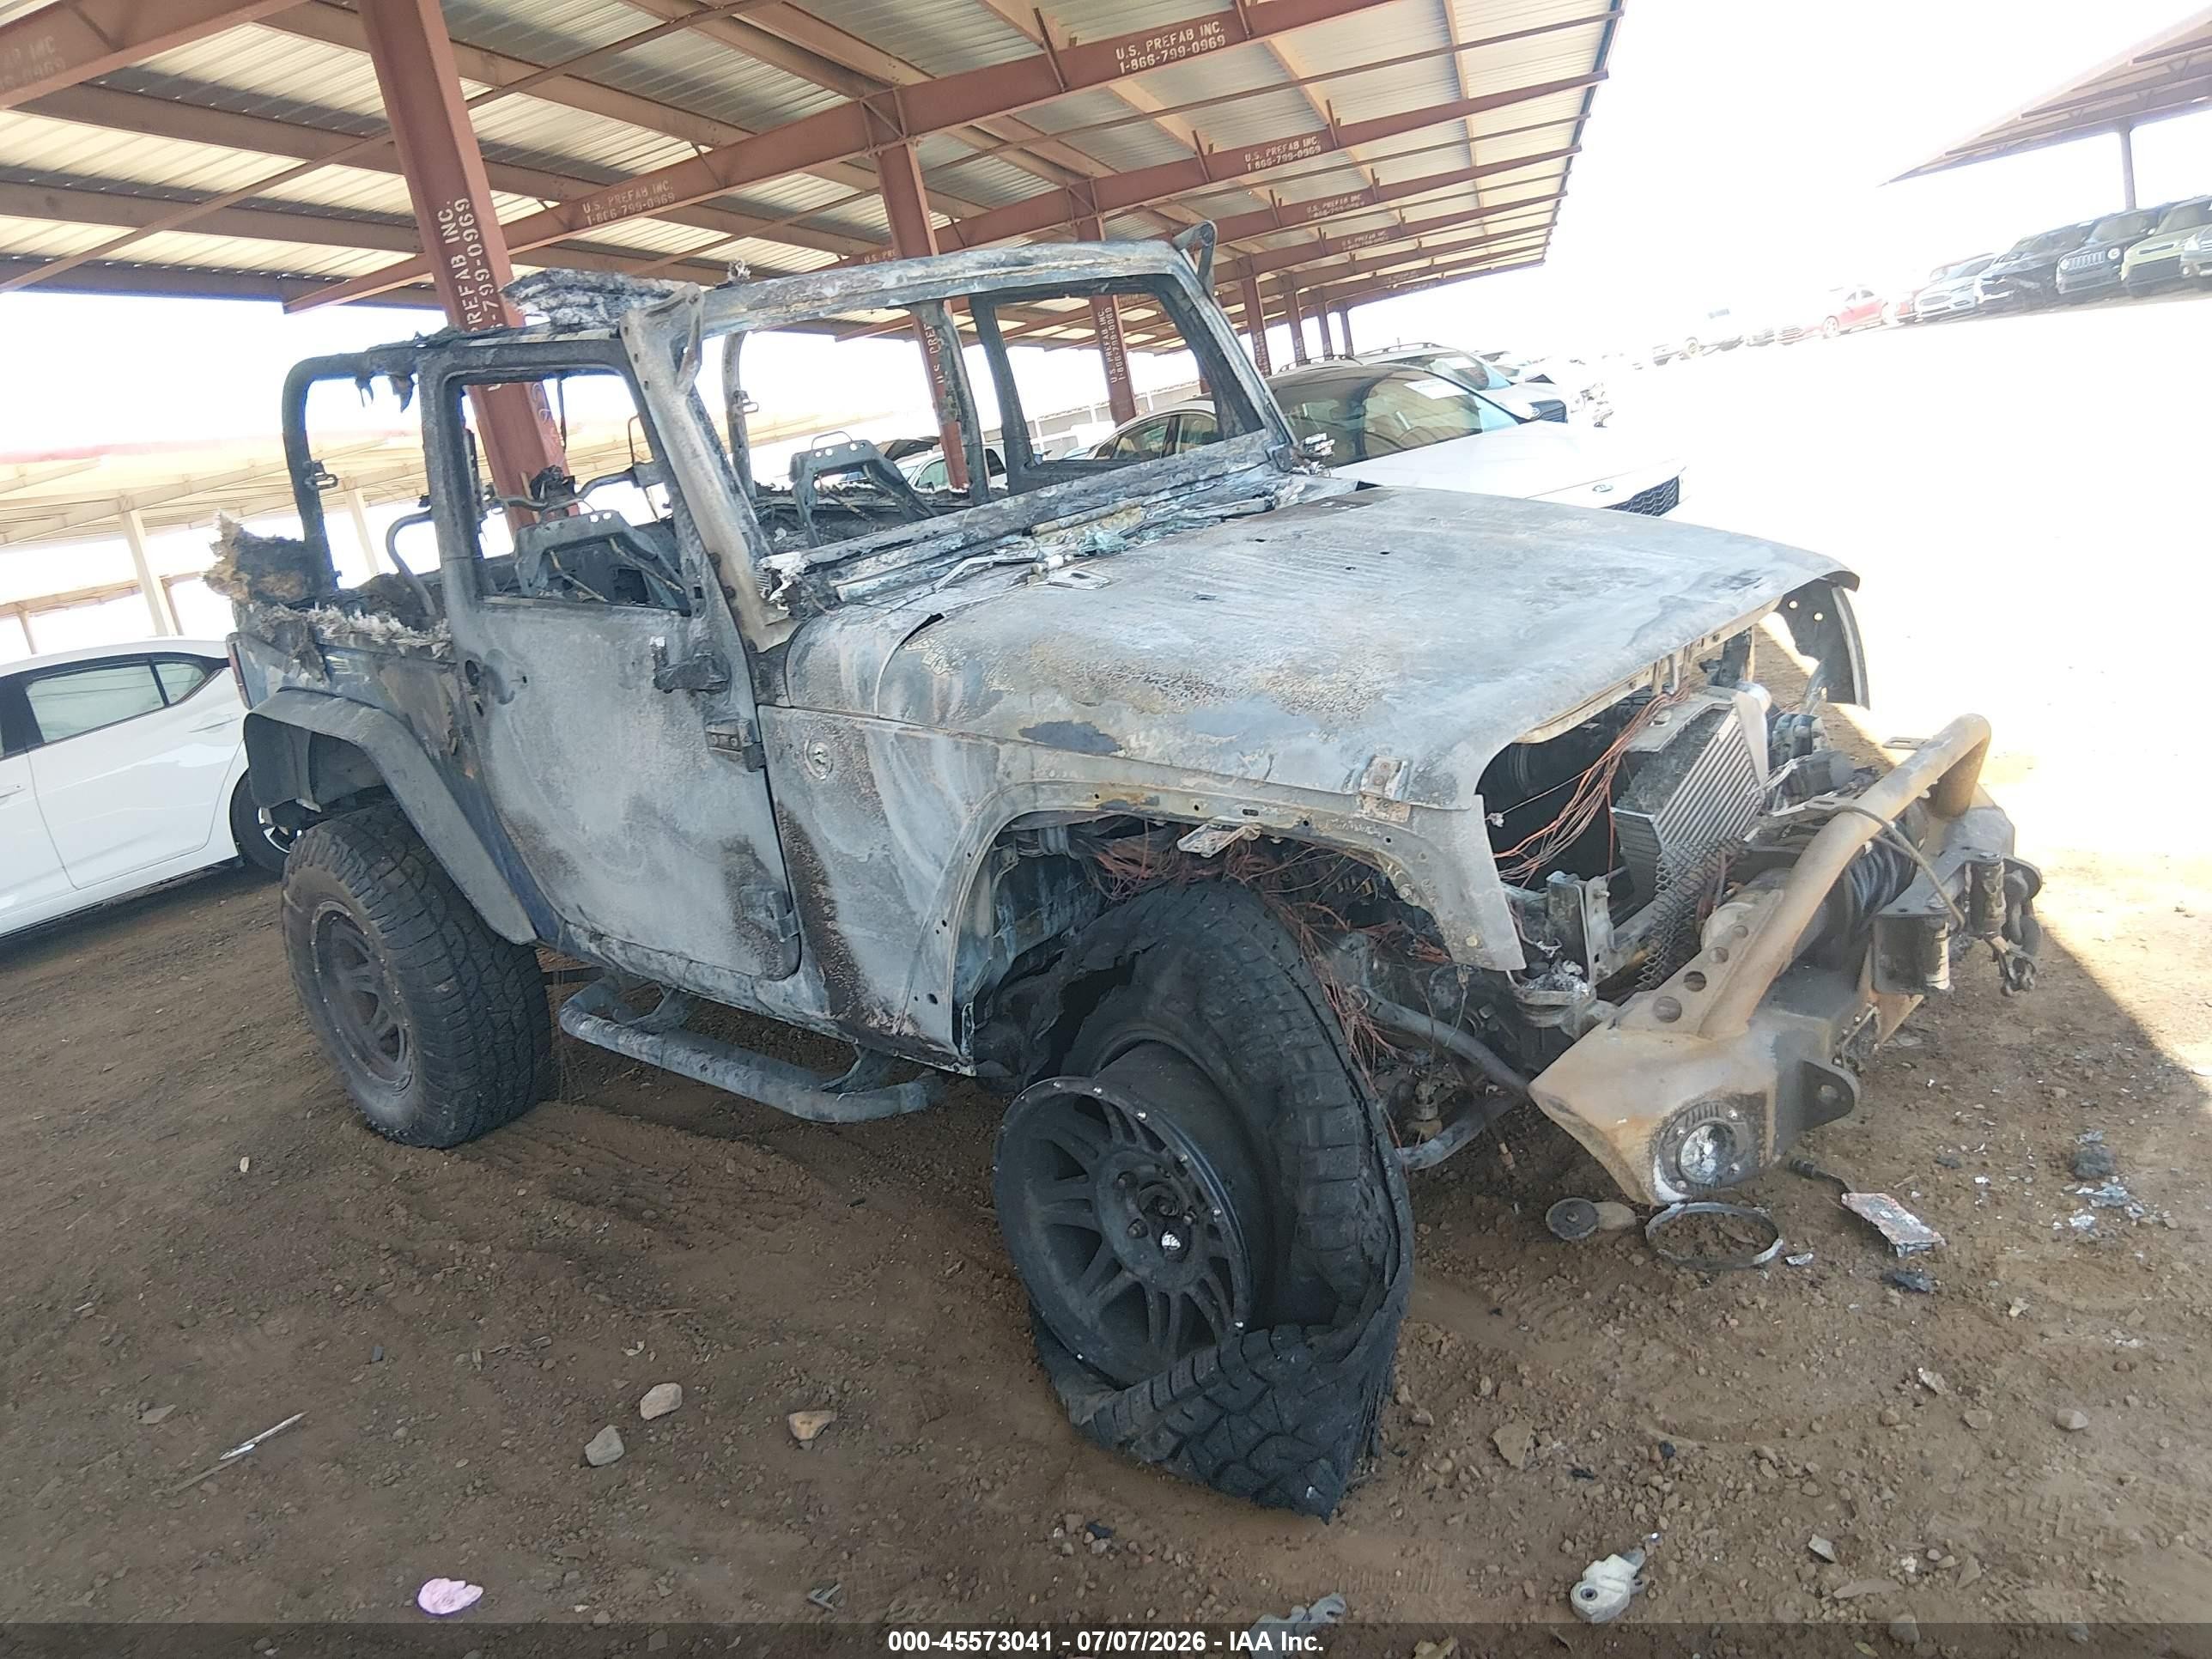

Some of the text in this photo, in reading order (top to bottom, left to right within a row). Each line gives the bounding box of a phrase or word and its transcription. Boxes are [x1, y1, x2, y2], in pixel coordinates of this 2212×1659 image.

[1115, 21, 1224, 60] U.S. PREFAB INC.
[1119, 34, 1226, 74] 1-866-799-0969
[652, 180, 673, 194] INC.
[438, 200, 460, 244] INC.
